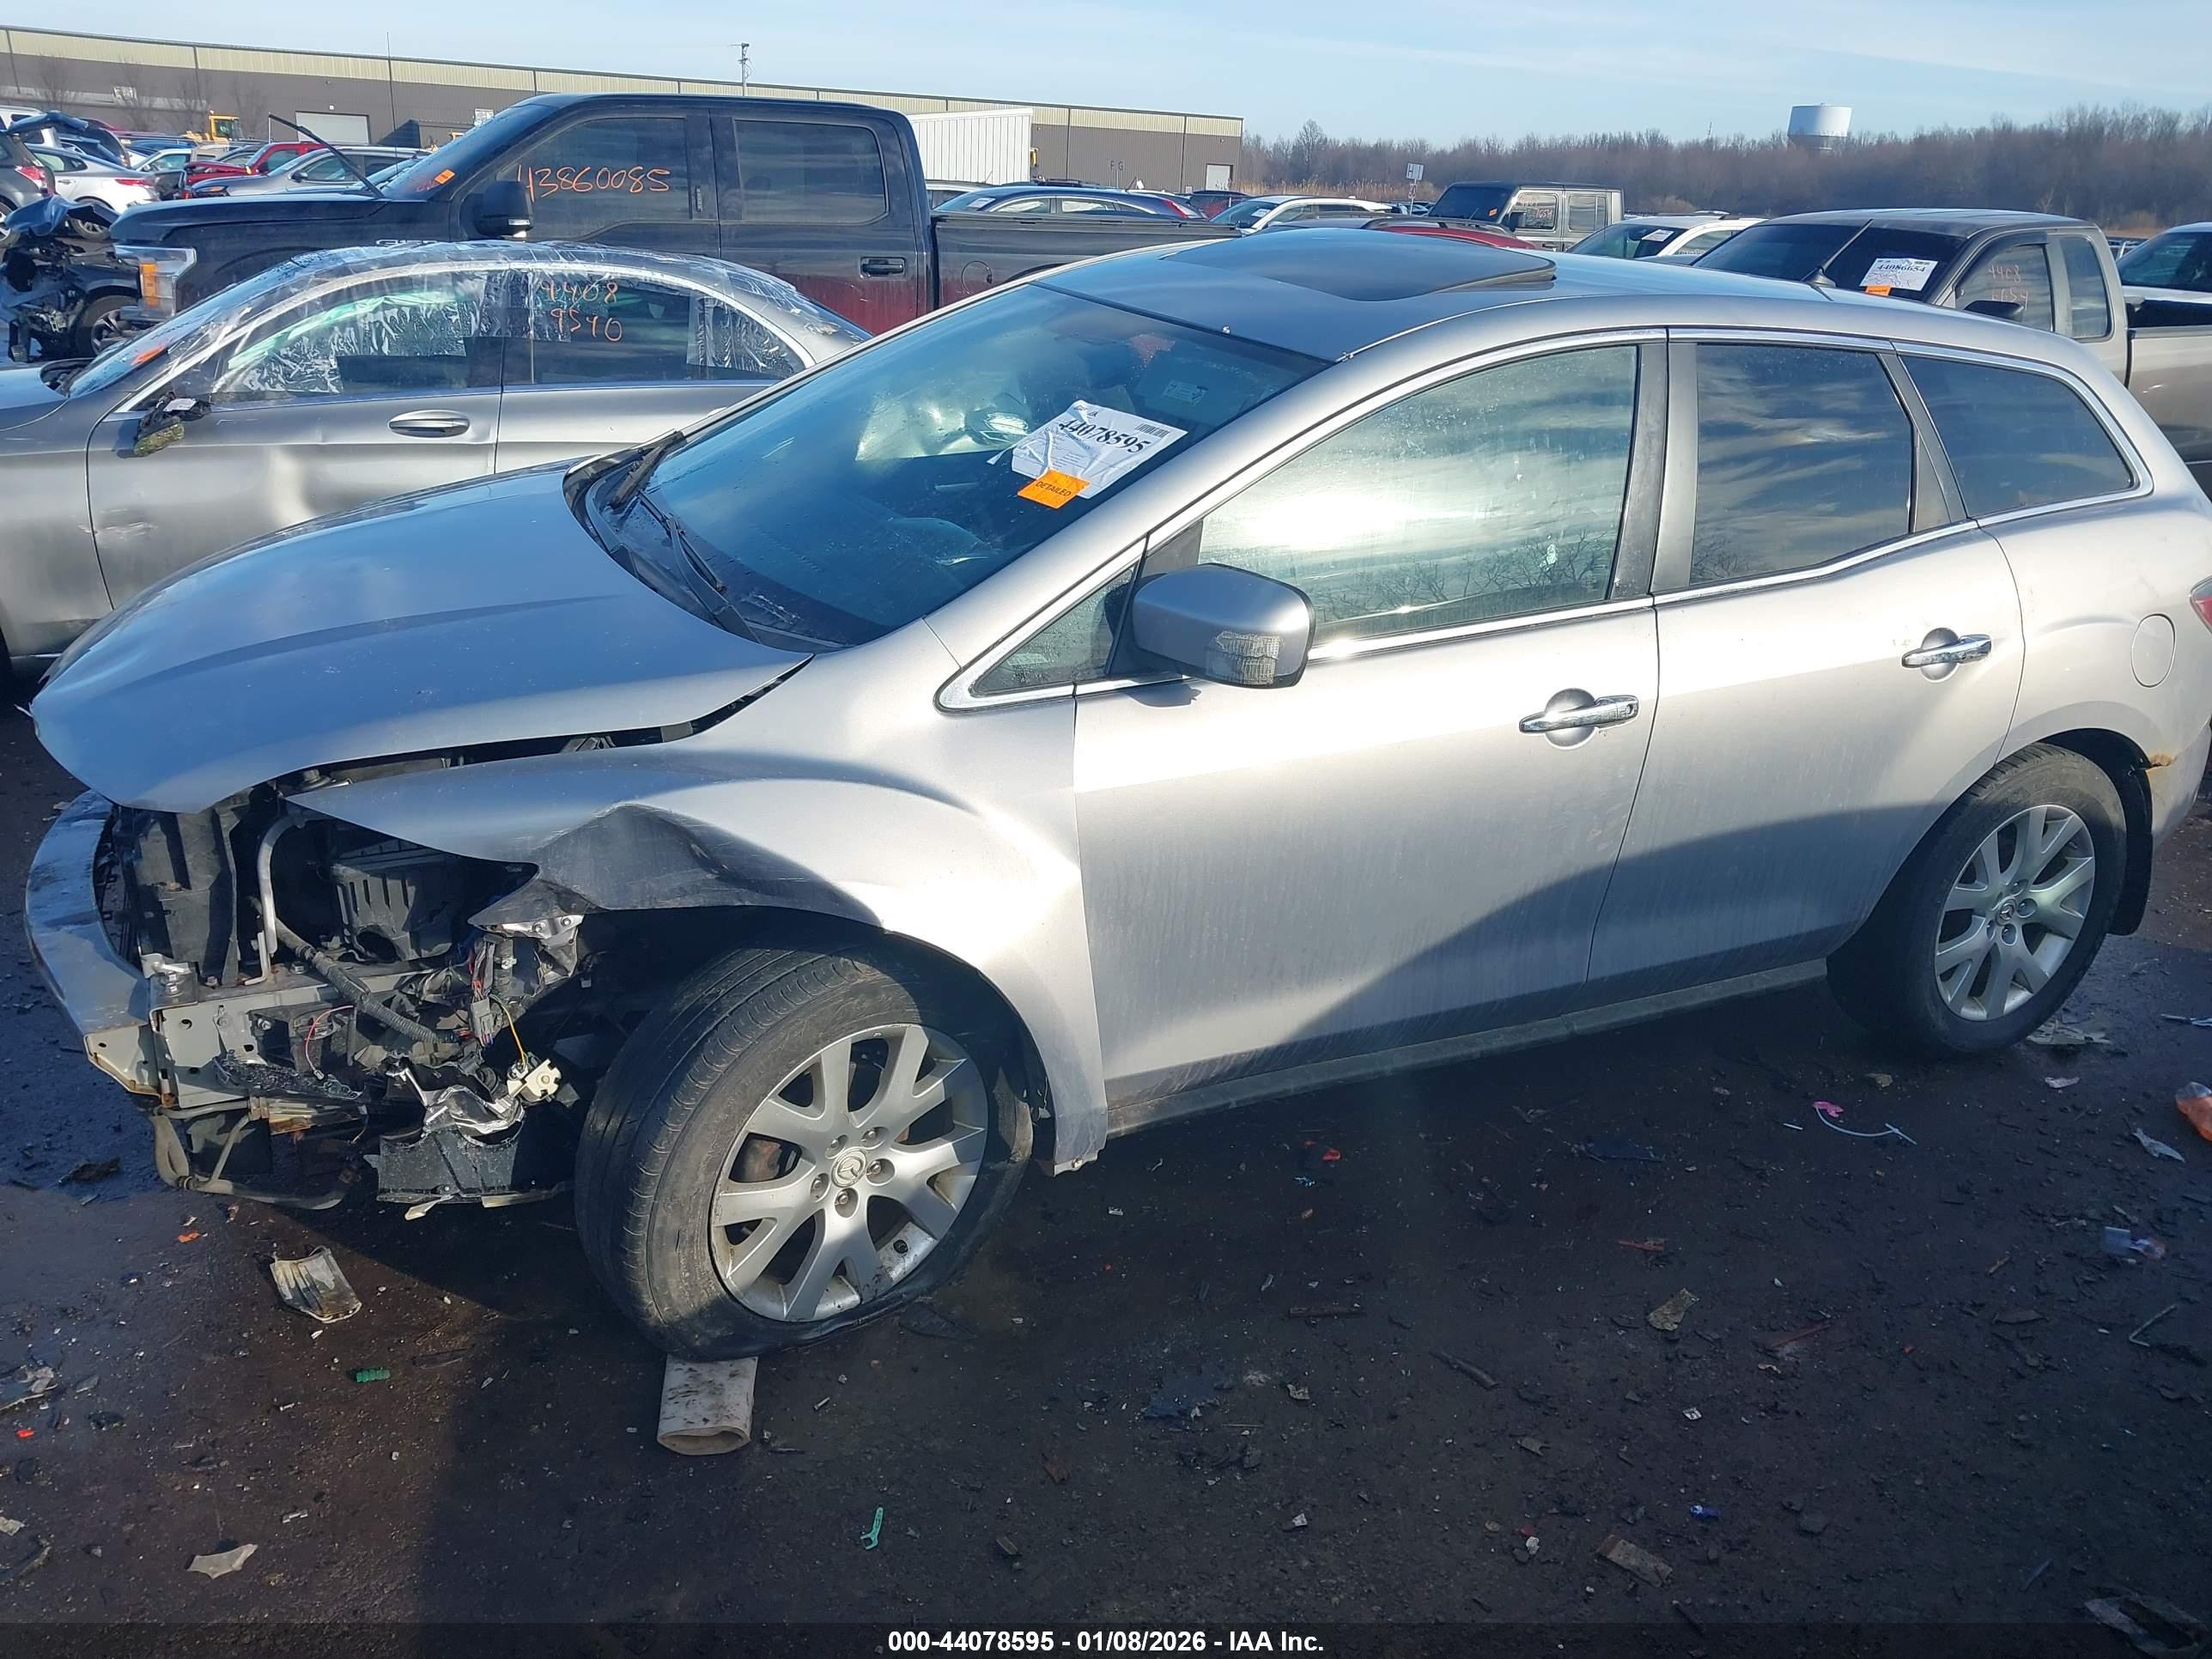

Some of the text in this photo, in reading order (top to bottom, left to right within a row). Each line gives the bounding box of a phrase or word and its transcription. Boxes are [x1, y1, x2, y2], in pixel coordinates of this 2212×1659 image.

[517, 164, 672, 204] 43860085
[1057, 418, 1152, 453] 44078595
[1035, 481, 1073, 496] DETAILED
